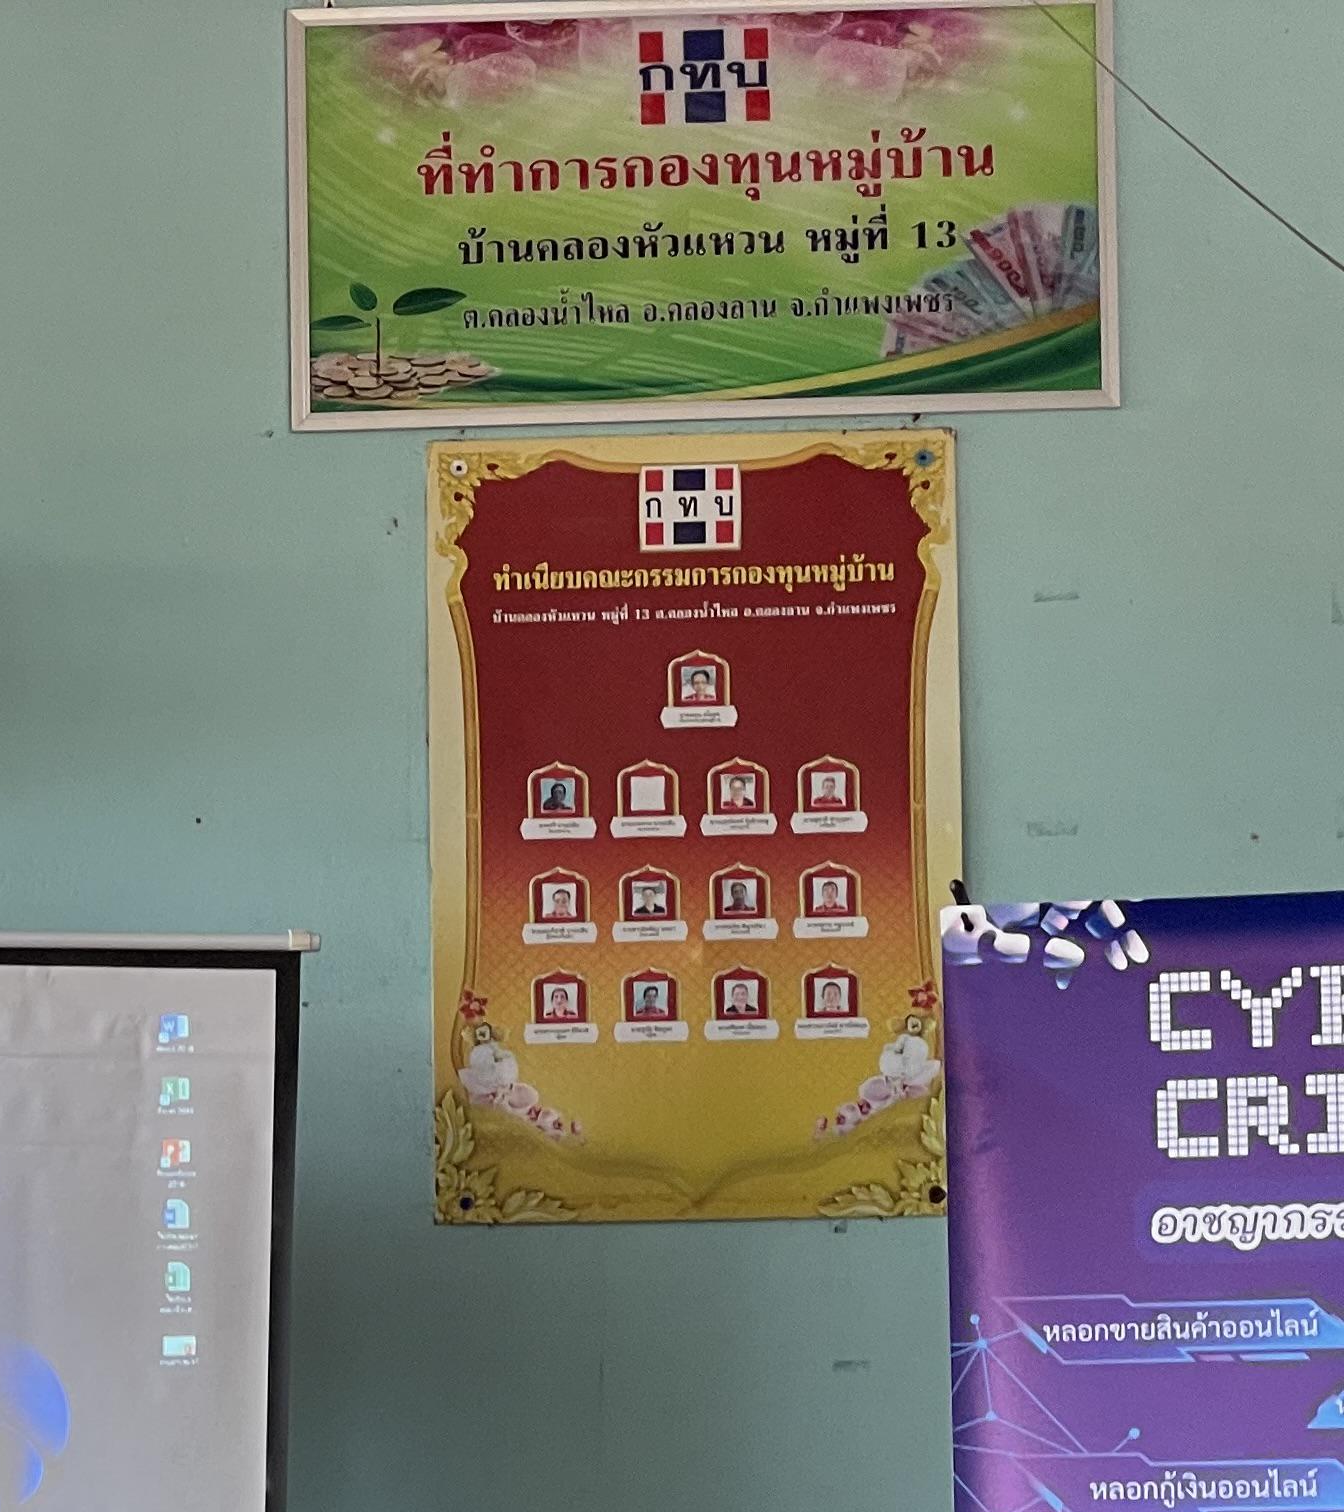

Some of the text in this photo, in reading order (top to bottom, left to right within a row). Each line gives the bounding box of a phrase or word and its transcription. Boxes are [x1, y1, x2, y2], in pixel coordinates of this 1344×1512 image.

[417, 126, 995, 200] ที่ทำการกองทุนหมู่บ้าน
[457, 203, 957, 266] บ้านคลองหัวแหวน หมู่ที่ 13
[463, 287, 955, 331] ต.คลองน้ำไหล อ.คลองลาน จ.กำแพงเพชร
[493, 554, 895, 593] ทำเนียบคณะกรรมการกองทุนหมู่บ้าน
[635, 608, 650, 620] 13
[1042, 1305, 1319, 1343] หลอกขายสินค้าออนไลน์
[1089, 1467, 1318, 1509] หลอกกู้เงินออนไลน์
